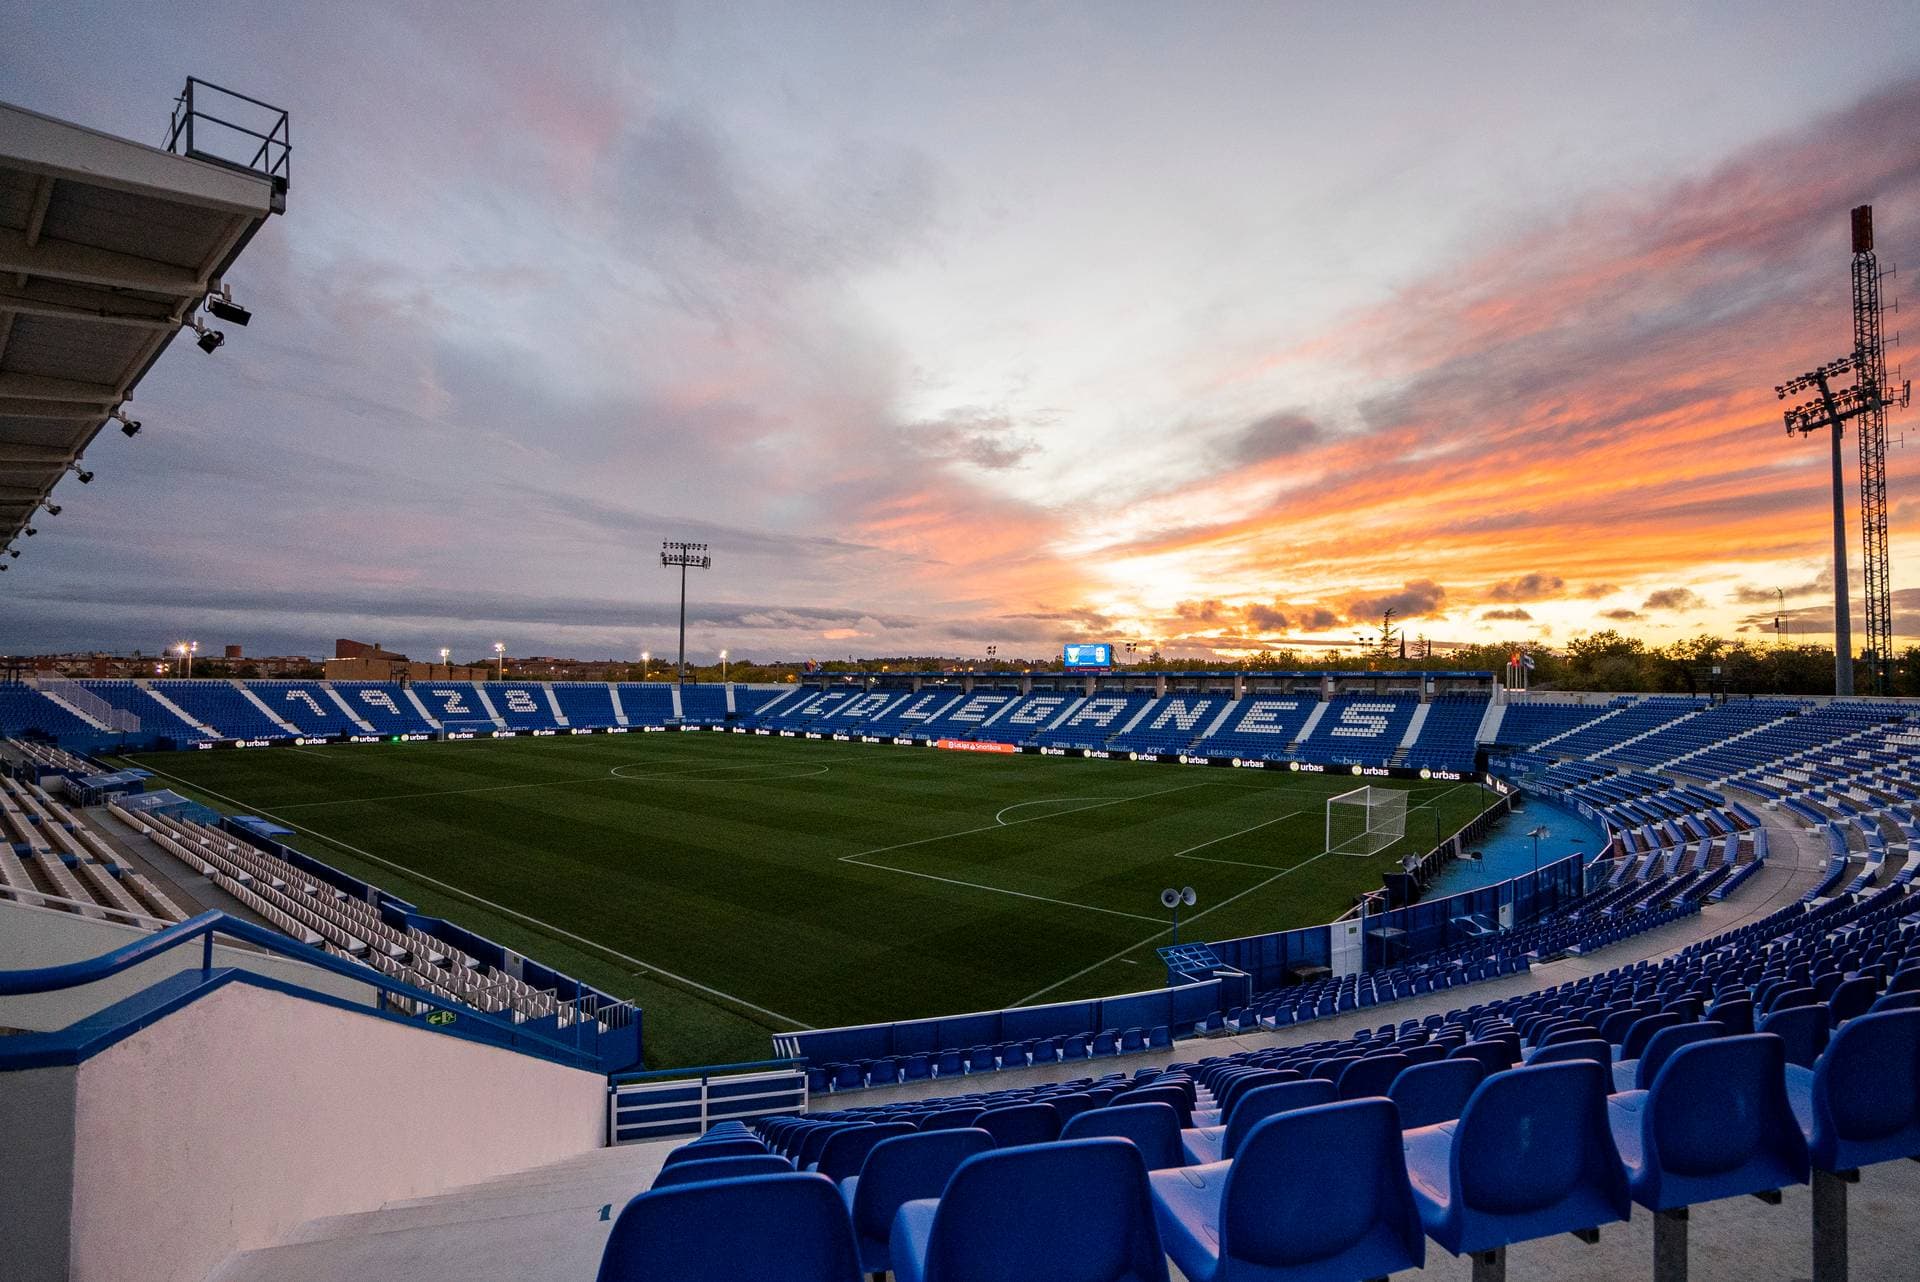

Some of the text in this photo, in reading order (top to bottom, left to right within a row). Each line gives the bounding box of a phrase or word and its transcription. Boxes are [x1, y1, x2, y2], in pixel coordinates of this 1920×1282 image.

[285, 690, 537, 716] 1928
[1091, 750, 1109, 758] urbas
[1147, 746, 1165, 754] KFC
[1176, 748, 1195, 756] KFC
[1138, 753, 1157, 761] urbas
[1188, 756, 1208, 764] urbas
[1242, 759, 1264, 768] urbas
[1300, 763, 1324, 772] urbas
[1363, 767, 1389, 776] urbas
[1432, 770, 1460, 780] urbas
